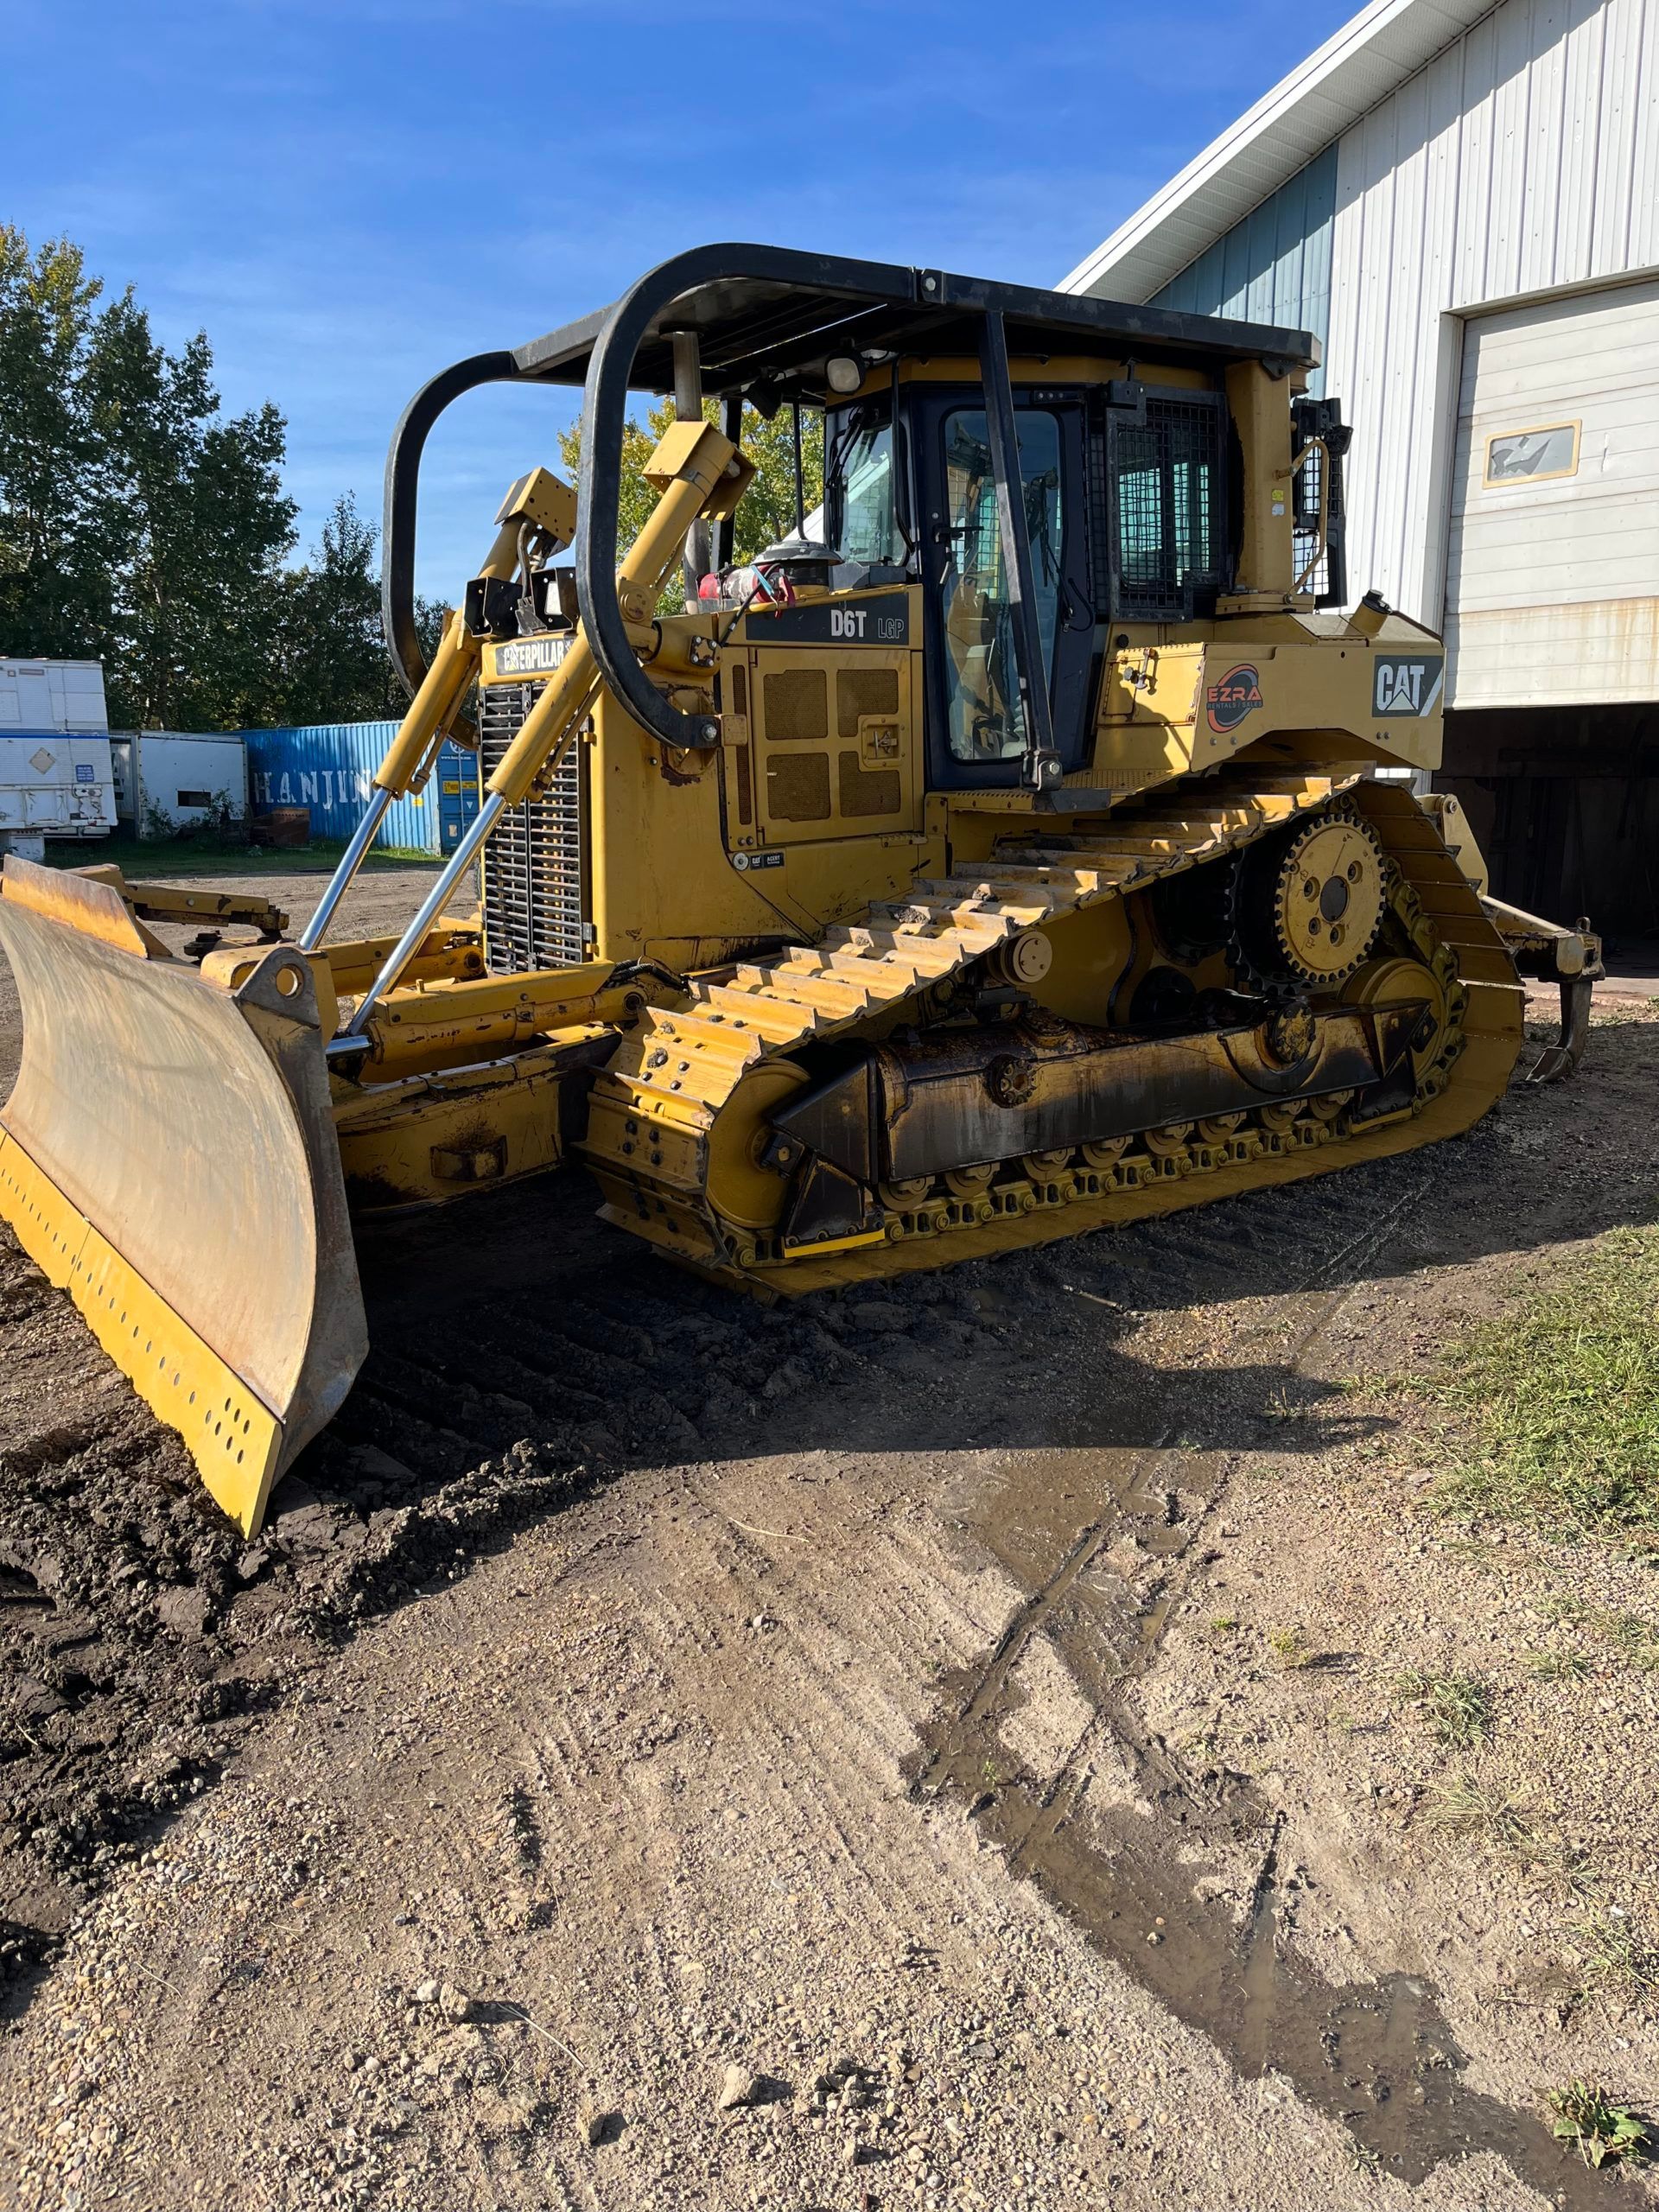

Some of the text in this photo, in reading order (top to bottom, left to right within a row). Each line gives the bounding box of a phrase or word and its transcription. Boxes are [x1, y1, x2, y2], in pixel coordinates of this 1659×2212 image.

[830, 609, 905, 639] D6T LGP
[504, 640, 564, 671] CATERPILLAR
[1208, 685, 1262, 702] EZRA
[1376, 664, 1425, 711] CAT
[254, 769, 371, 810] HANJIN
